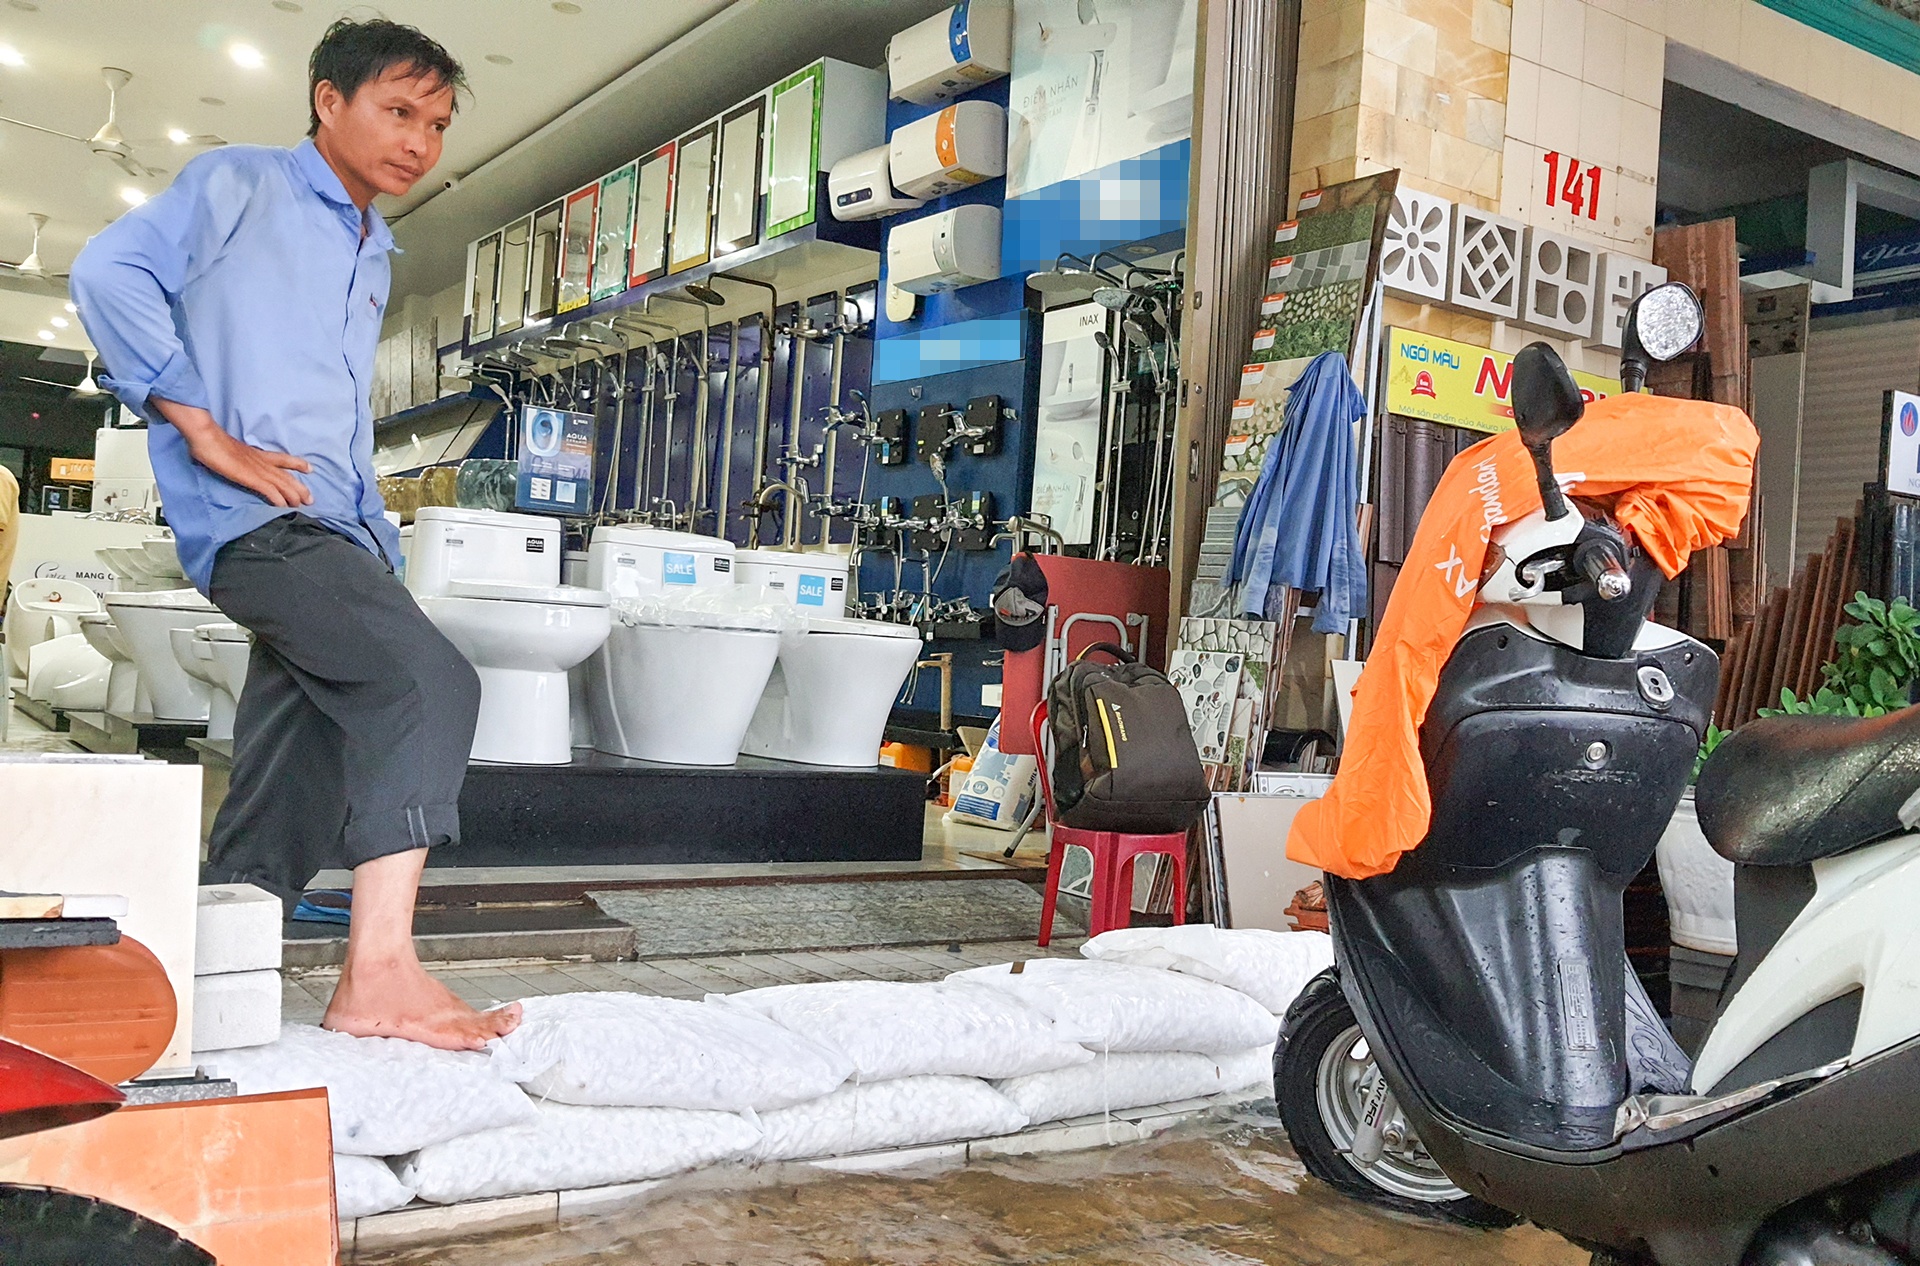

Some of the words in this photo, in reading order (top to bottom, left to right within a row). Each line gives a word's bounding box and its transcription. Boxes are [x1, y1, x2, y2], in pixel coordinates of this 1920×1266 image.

[1544, 150, 1601, 221] 141
[1079, 313, 1099, 327] INAX
[1400, 343, 1429, 363] NGÓI
[1417, 408, 1431, 418] sản
[1458, 417, 1474, 427] của
[566, 433, 587, 441] AQUA
[75, 571, 105, 579] MANG
[666, 562, 694, 575] SALE
[800, 584, 822, 597] SALE
